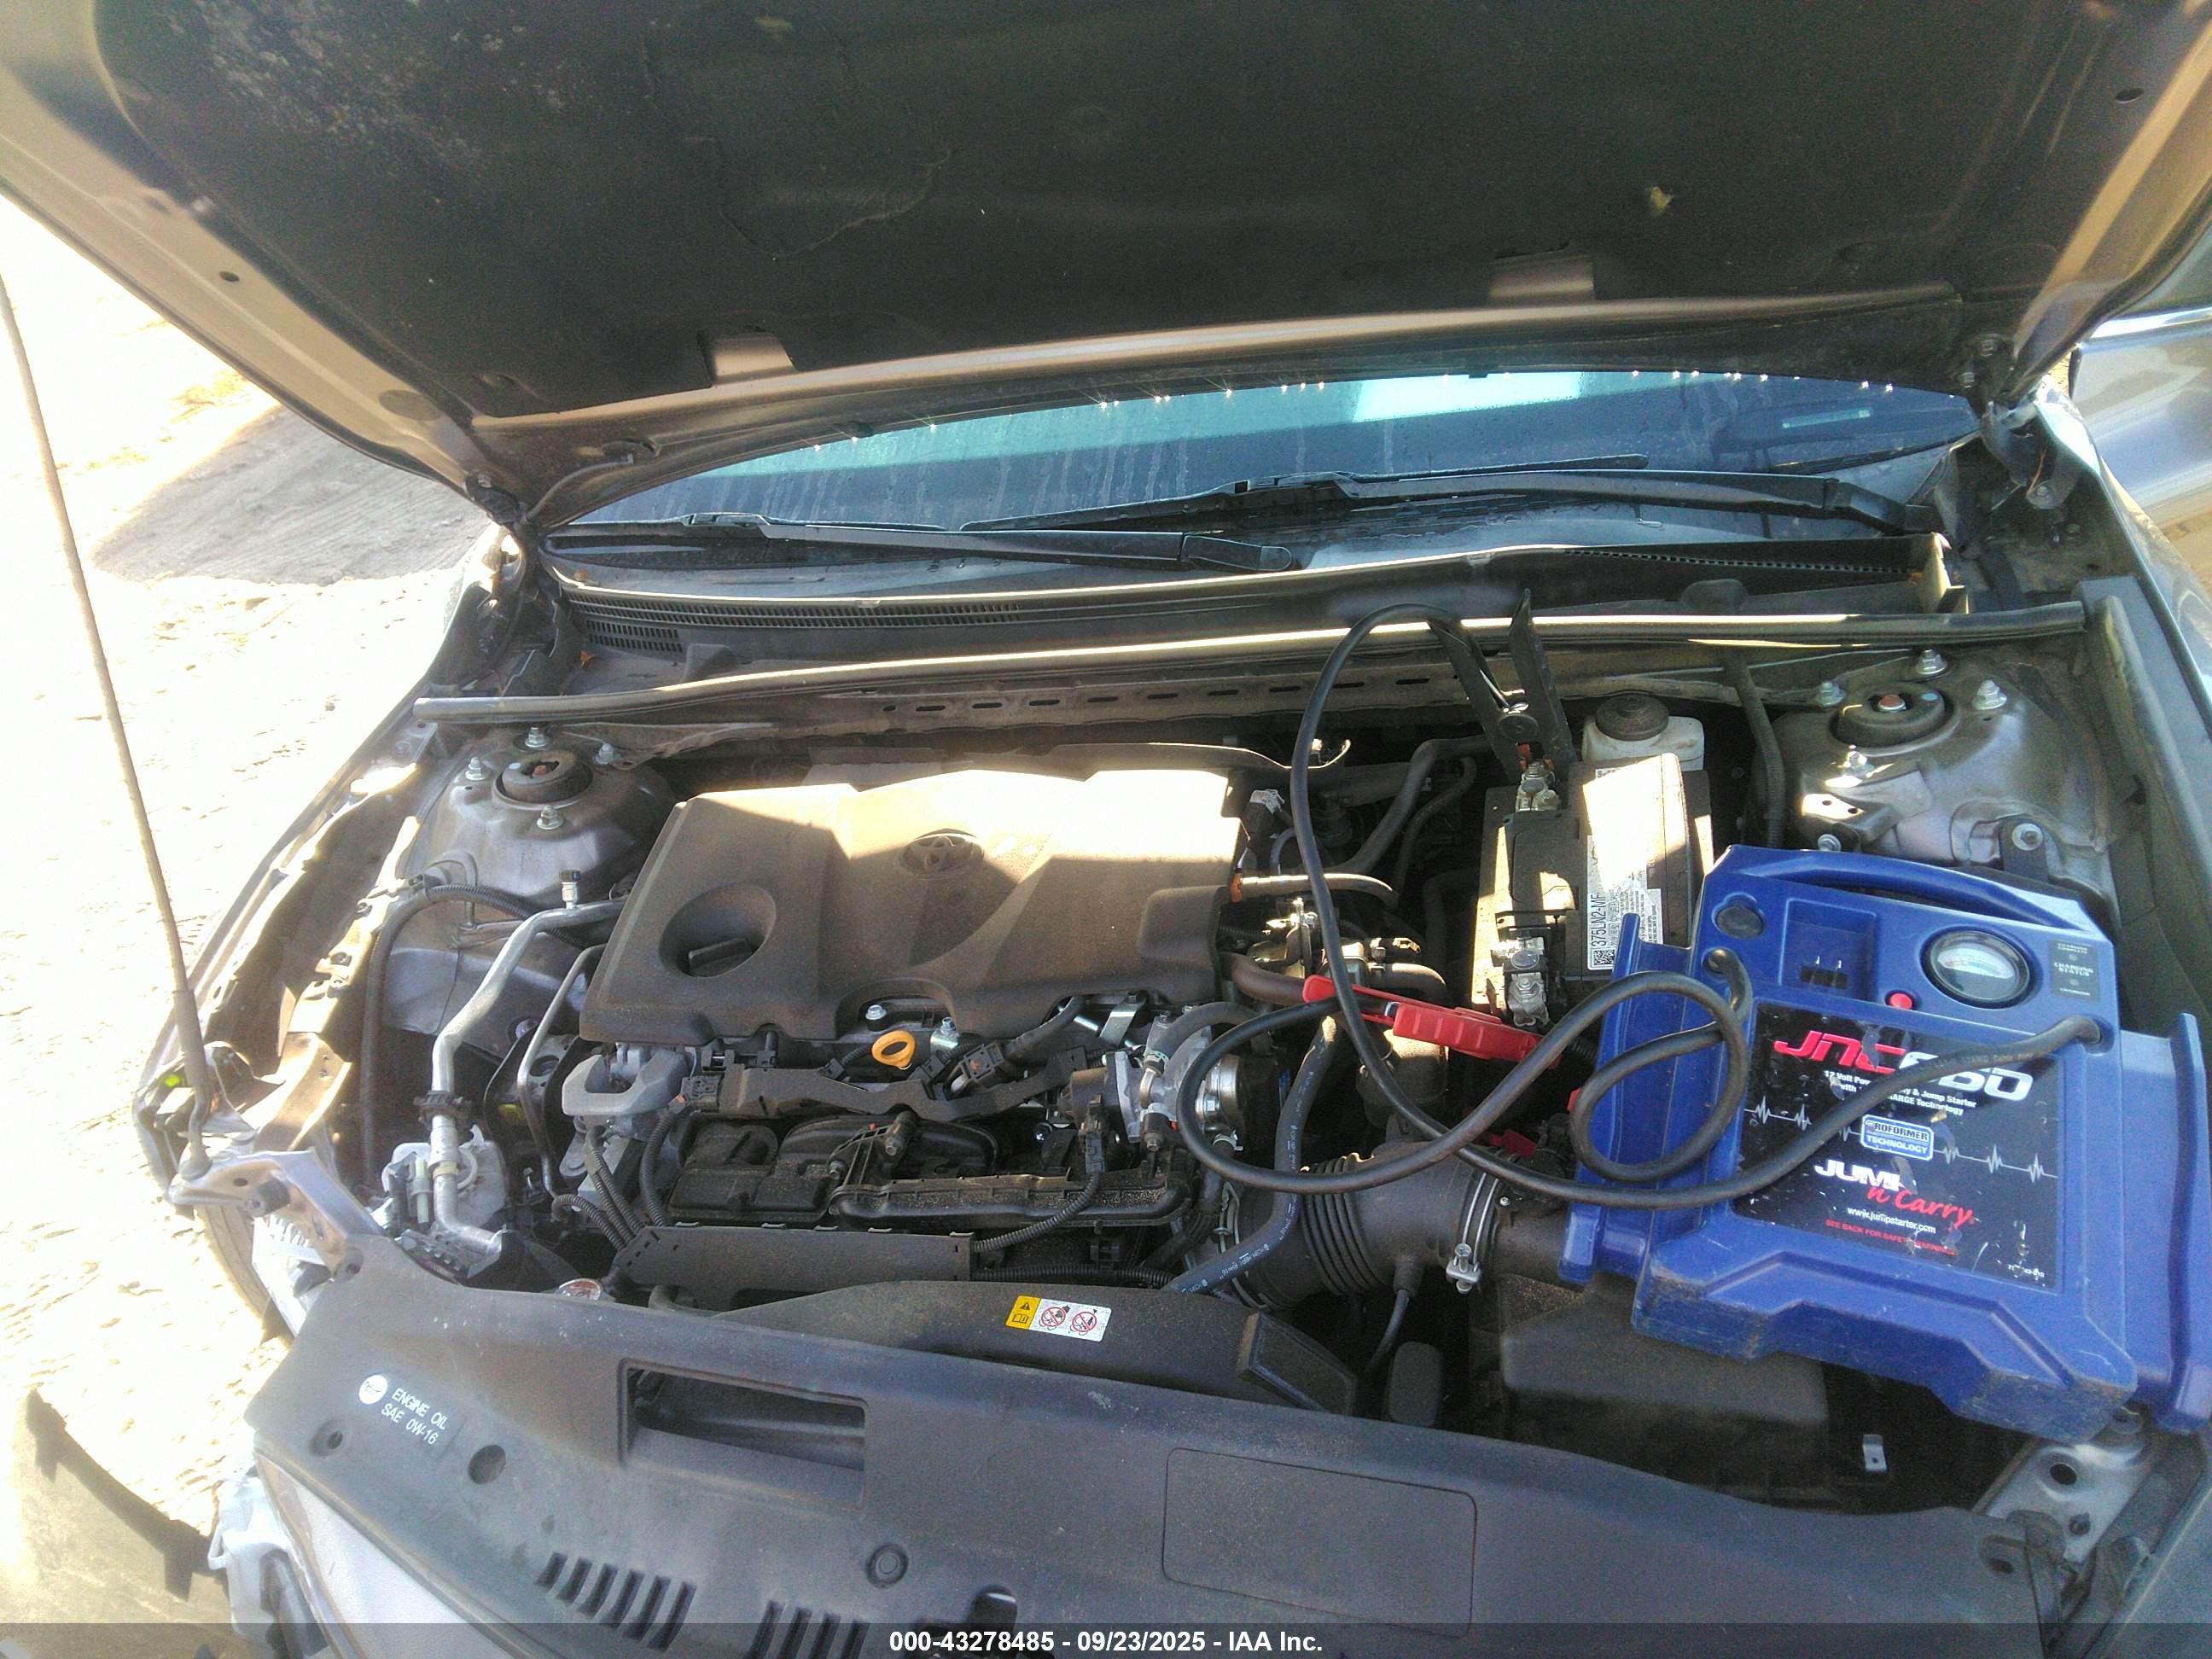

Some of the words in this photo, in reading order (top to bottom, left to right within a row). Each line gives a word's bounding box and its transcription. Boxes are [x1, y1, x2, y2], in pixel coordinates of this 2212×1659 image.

[1837, 1072, 1854, 1083] Volt
[1921, 1091, 1946, 1103] Jump
[1947, 1095, 1977, 1109] Starter
[1866, 1120, 1929, 1141] ROFORMER
[1866, 1134, 1929, 1155] TECHNOLOGY
[1894, 1189, 1974, 1230] Carry
[1842, 1223, 1863, 1234] BACK
[1865, 1228, 1882, 1238] FOR
[381, 1403, 405, 1423] SAE
[405, 1418, 439, 1445] 0W-16
[392, 1388, 430, 1417] ENGINE
[430, 1412, 448, 1430] OIL
